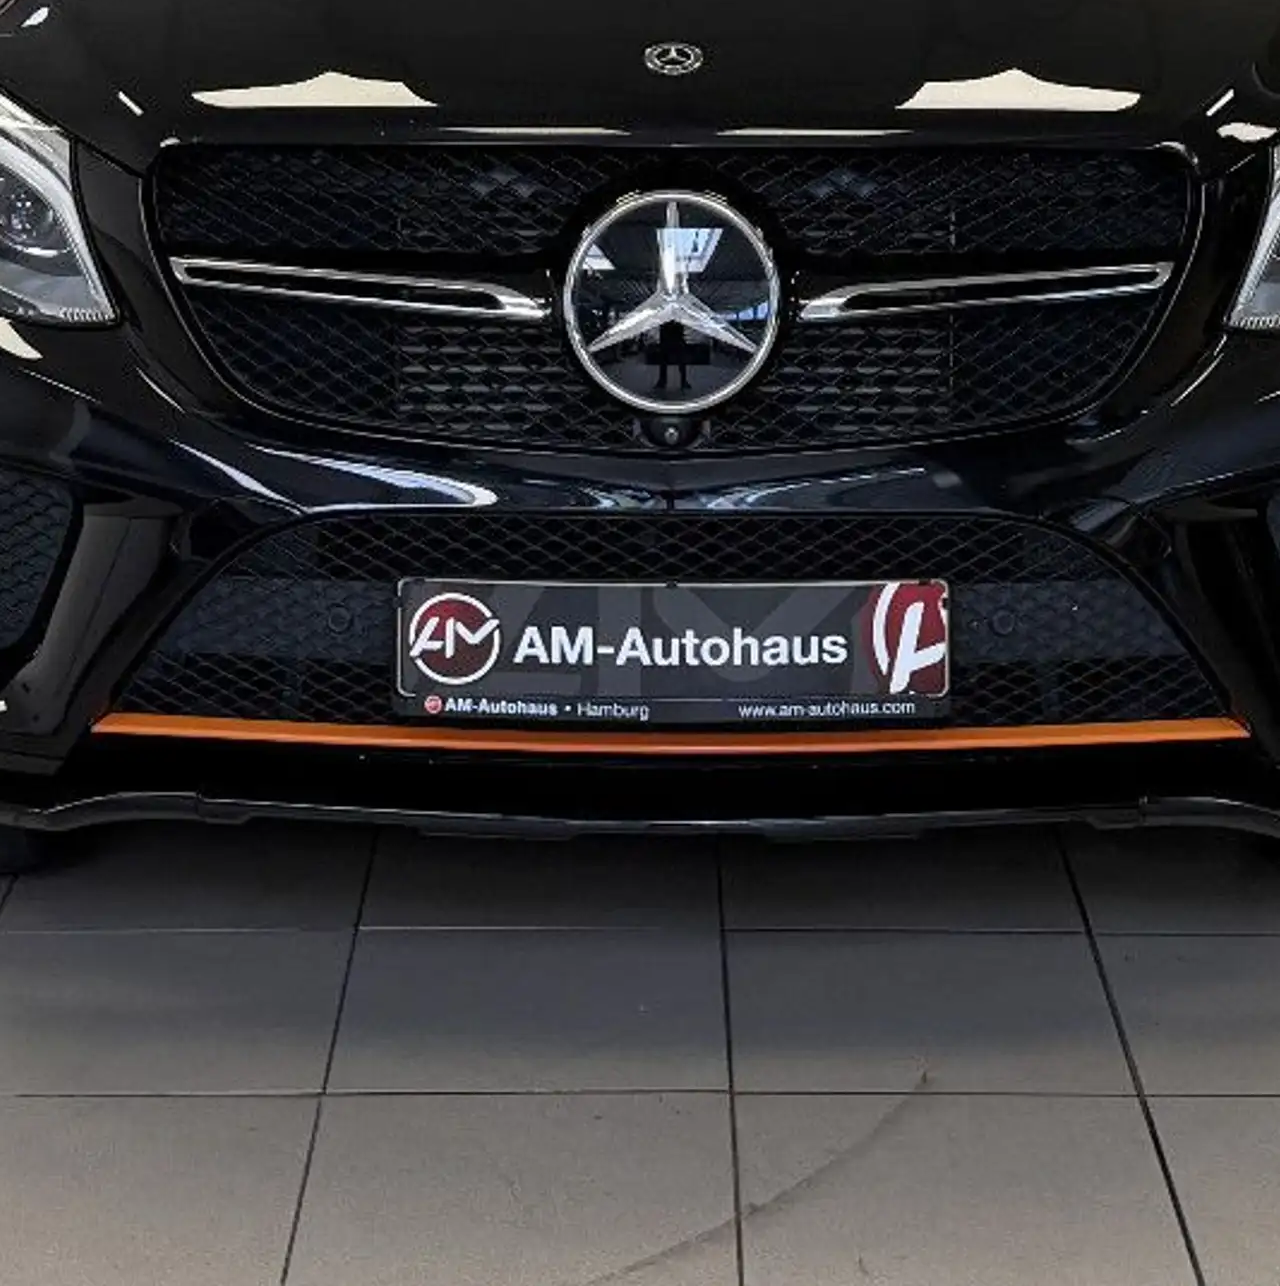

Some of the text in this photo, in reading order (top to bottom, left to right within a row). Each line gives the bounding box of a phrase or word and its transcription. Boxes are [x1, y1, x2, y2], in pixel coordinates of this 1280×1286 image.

[512, 625, 849, 668] AM-Autohaus
[444, 697, 558, 716] AM-Autohaus
[576, 701, 650, 722] Hamburg
[737, 700, 917, 719] www.am-autohaus.com
